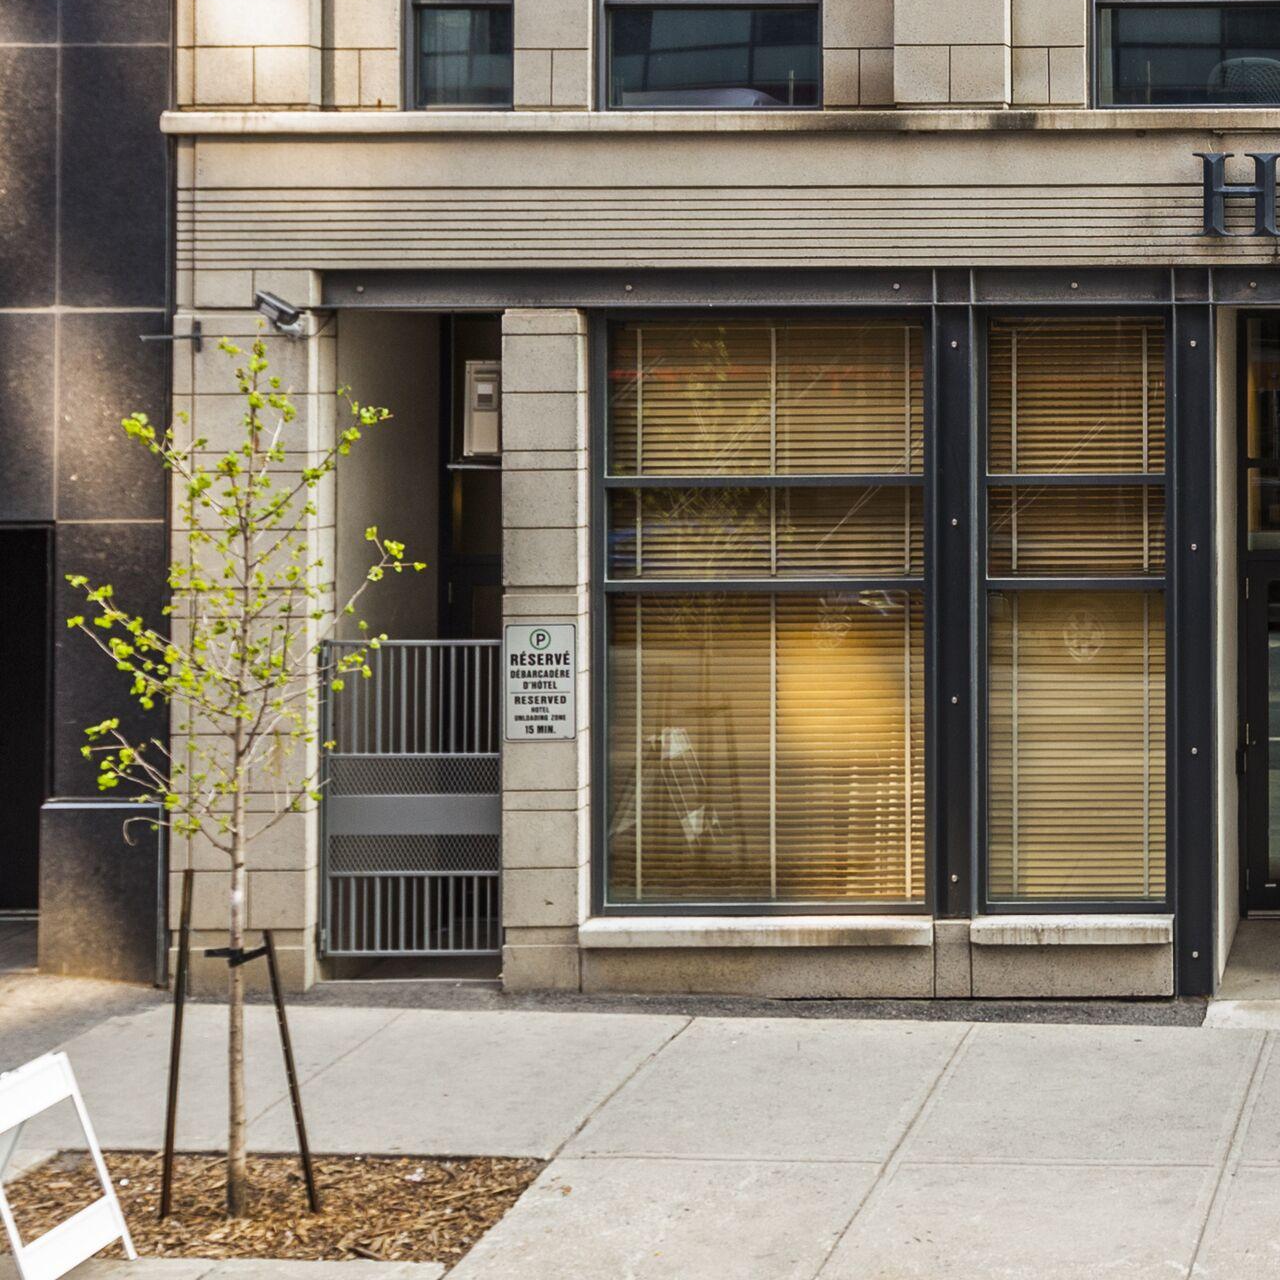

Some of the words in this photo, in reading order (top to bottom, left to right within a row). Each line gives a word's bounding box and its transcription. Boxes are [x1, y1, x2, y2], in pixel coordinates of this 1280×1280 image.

[535, 633, 547, 646] P
[510, 650, 571, 666] RÉSERVÉ
[523, 680, 558, 690] D'HÔTEL
[514, 695, 567, 705] RESERVED
[525, 725, 535, 735] 15
